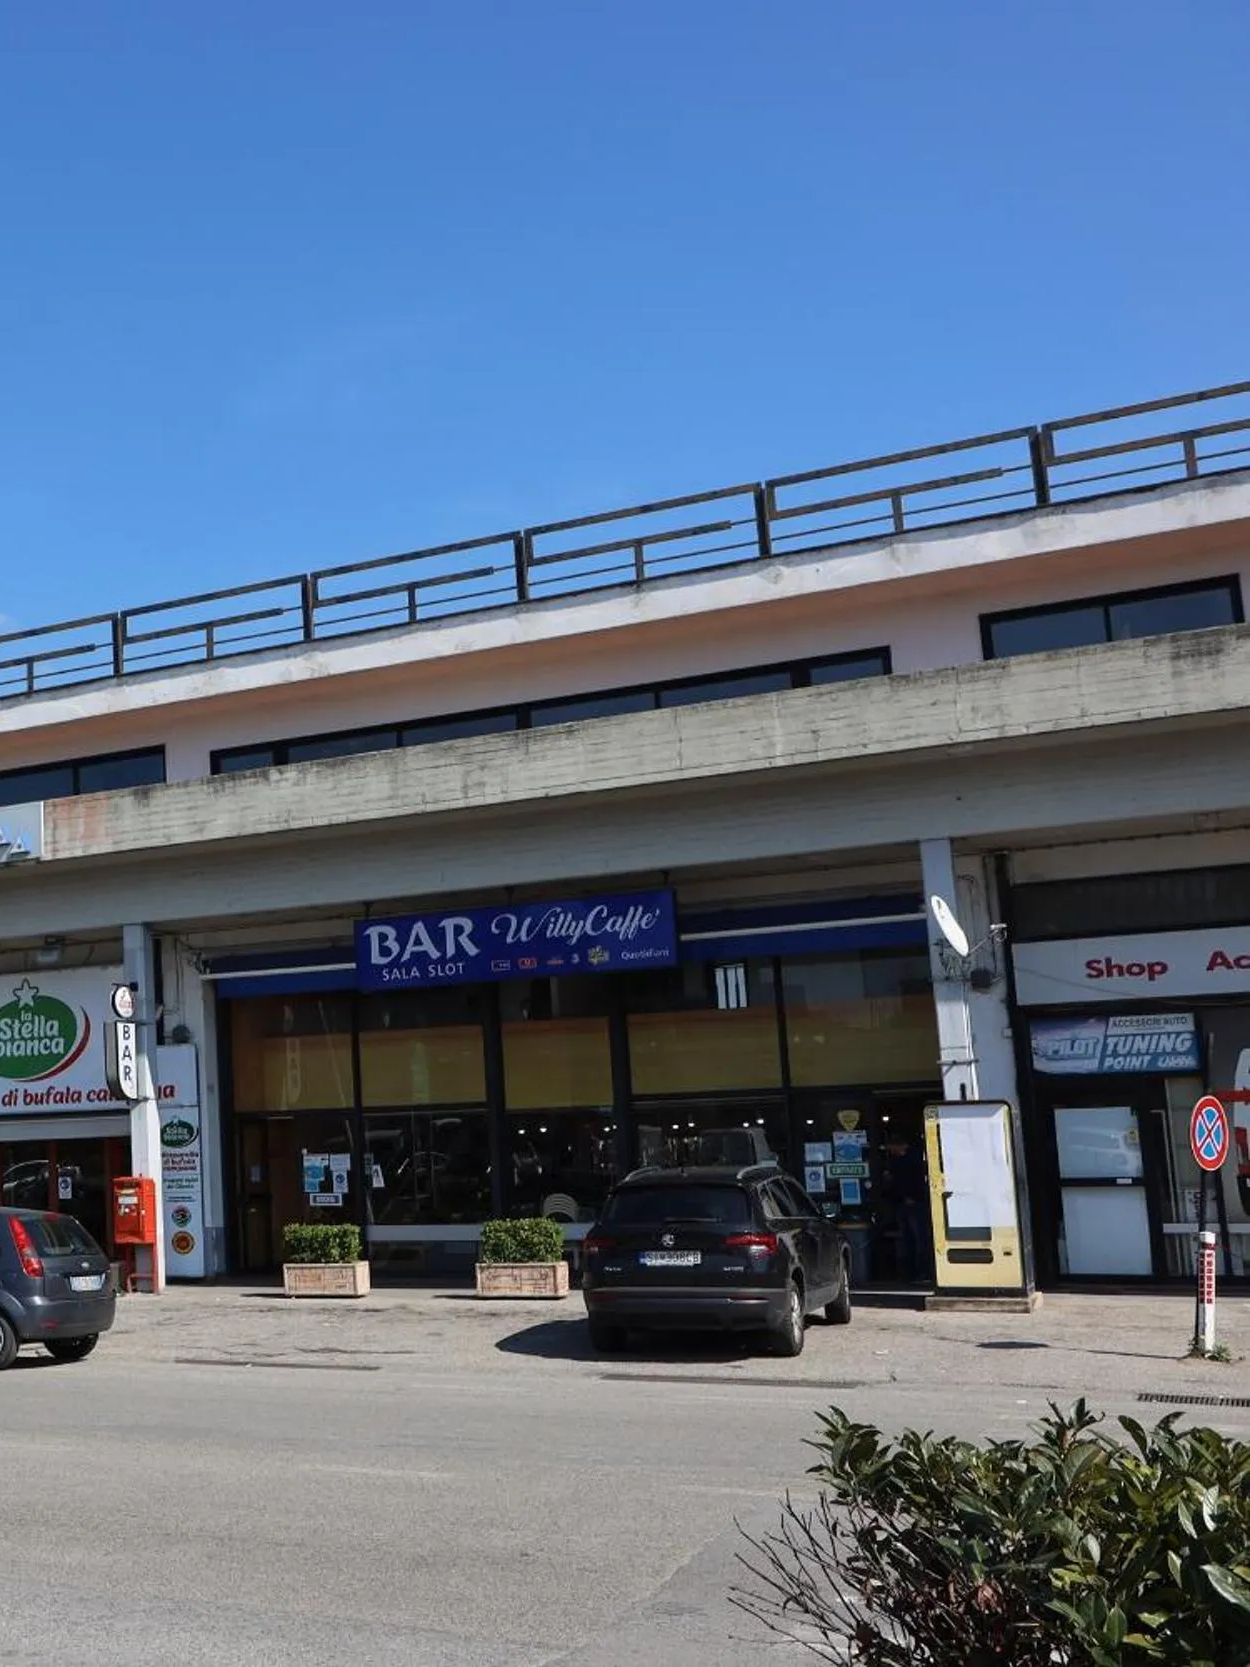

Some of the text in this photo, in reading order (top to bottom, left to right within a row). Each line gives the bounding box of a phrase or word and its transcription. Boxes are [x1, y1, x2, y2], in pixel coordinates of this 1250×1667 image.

[363, 916, 482, 965] BAR
[382, 962, 465, 981] SALA SLOT
[1085, 956, 1168, 981] Shop
[20, 1009, 33, 1022] la
[122, 1025, 132, 1081] BAR
[1049, 1038, 1098, 1056] PILOT
[1105, 1032, 1193, 1055] TUNING
[1103, 1056, 1150, 1070] POINT
[1, 1087, 19, 1107] di
[23, 1086, 82, 1106] bufala
